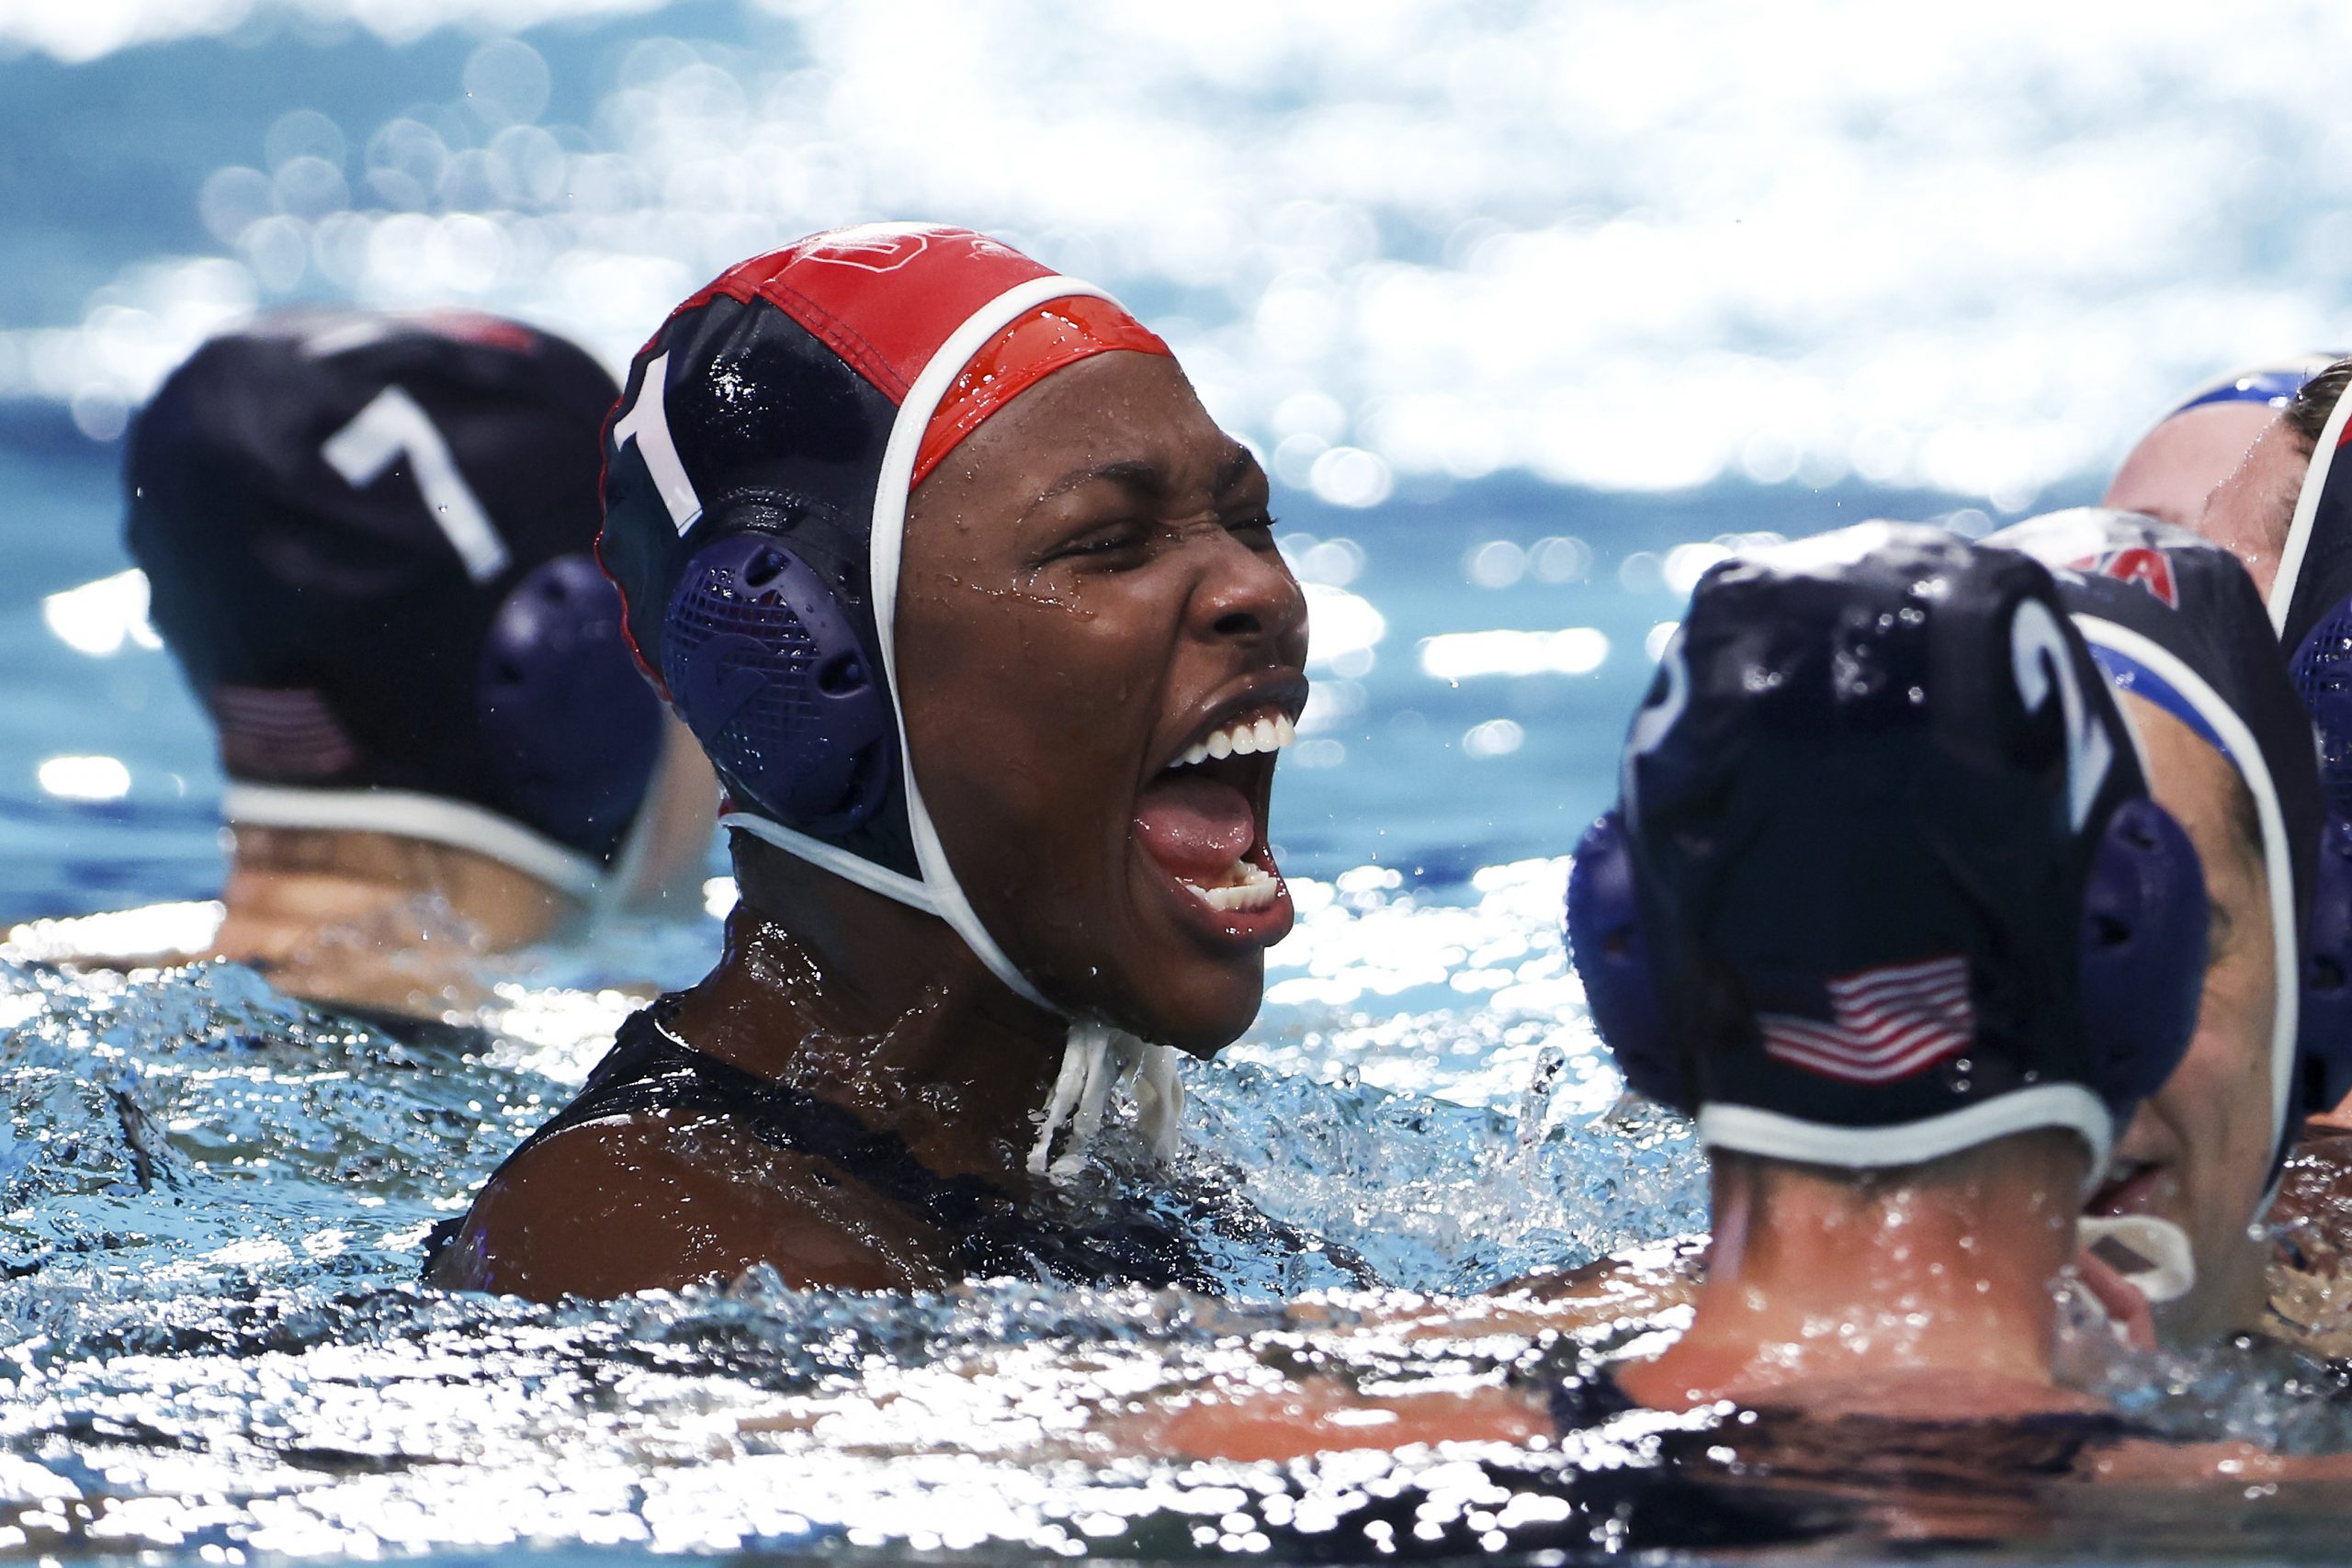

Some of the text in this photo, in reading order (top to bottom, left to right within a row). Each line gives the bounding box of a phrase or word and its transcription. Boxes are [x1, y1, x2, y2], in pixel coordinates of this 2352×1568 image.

[321, 385, 511, 583] 7
[613, 350, 703, 537] 1
[2010, 598, 2113, 834] 2
